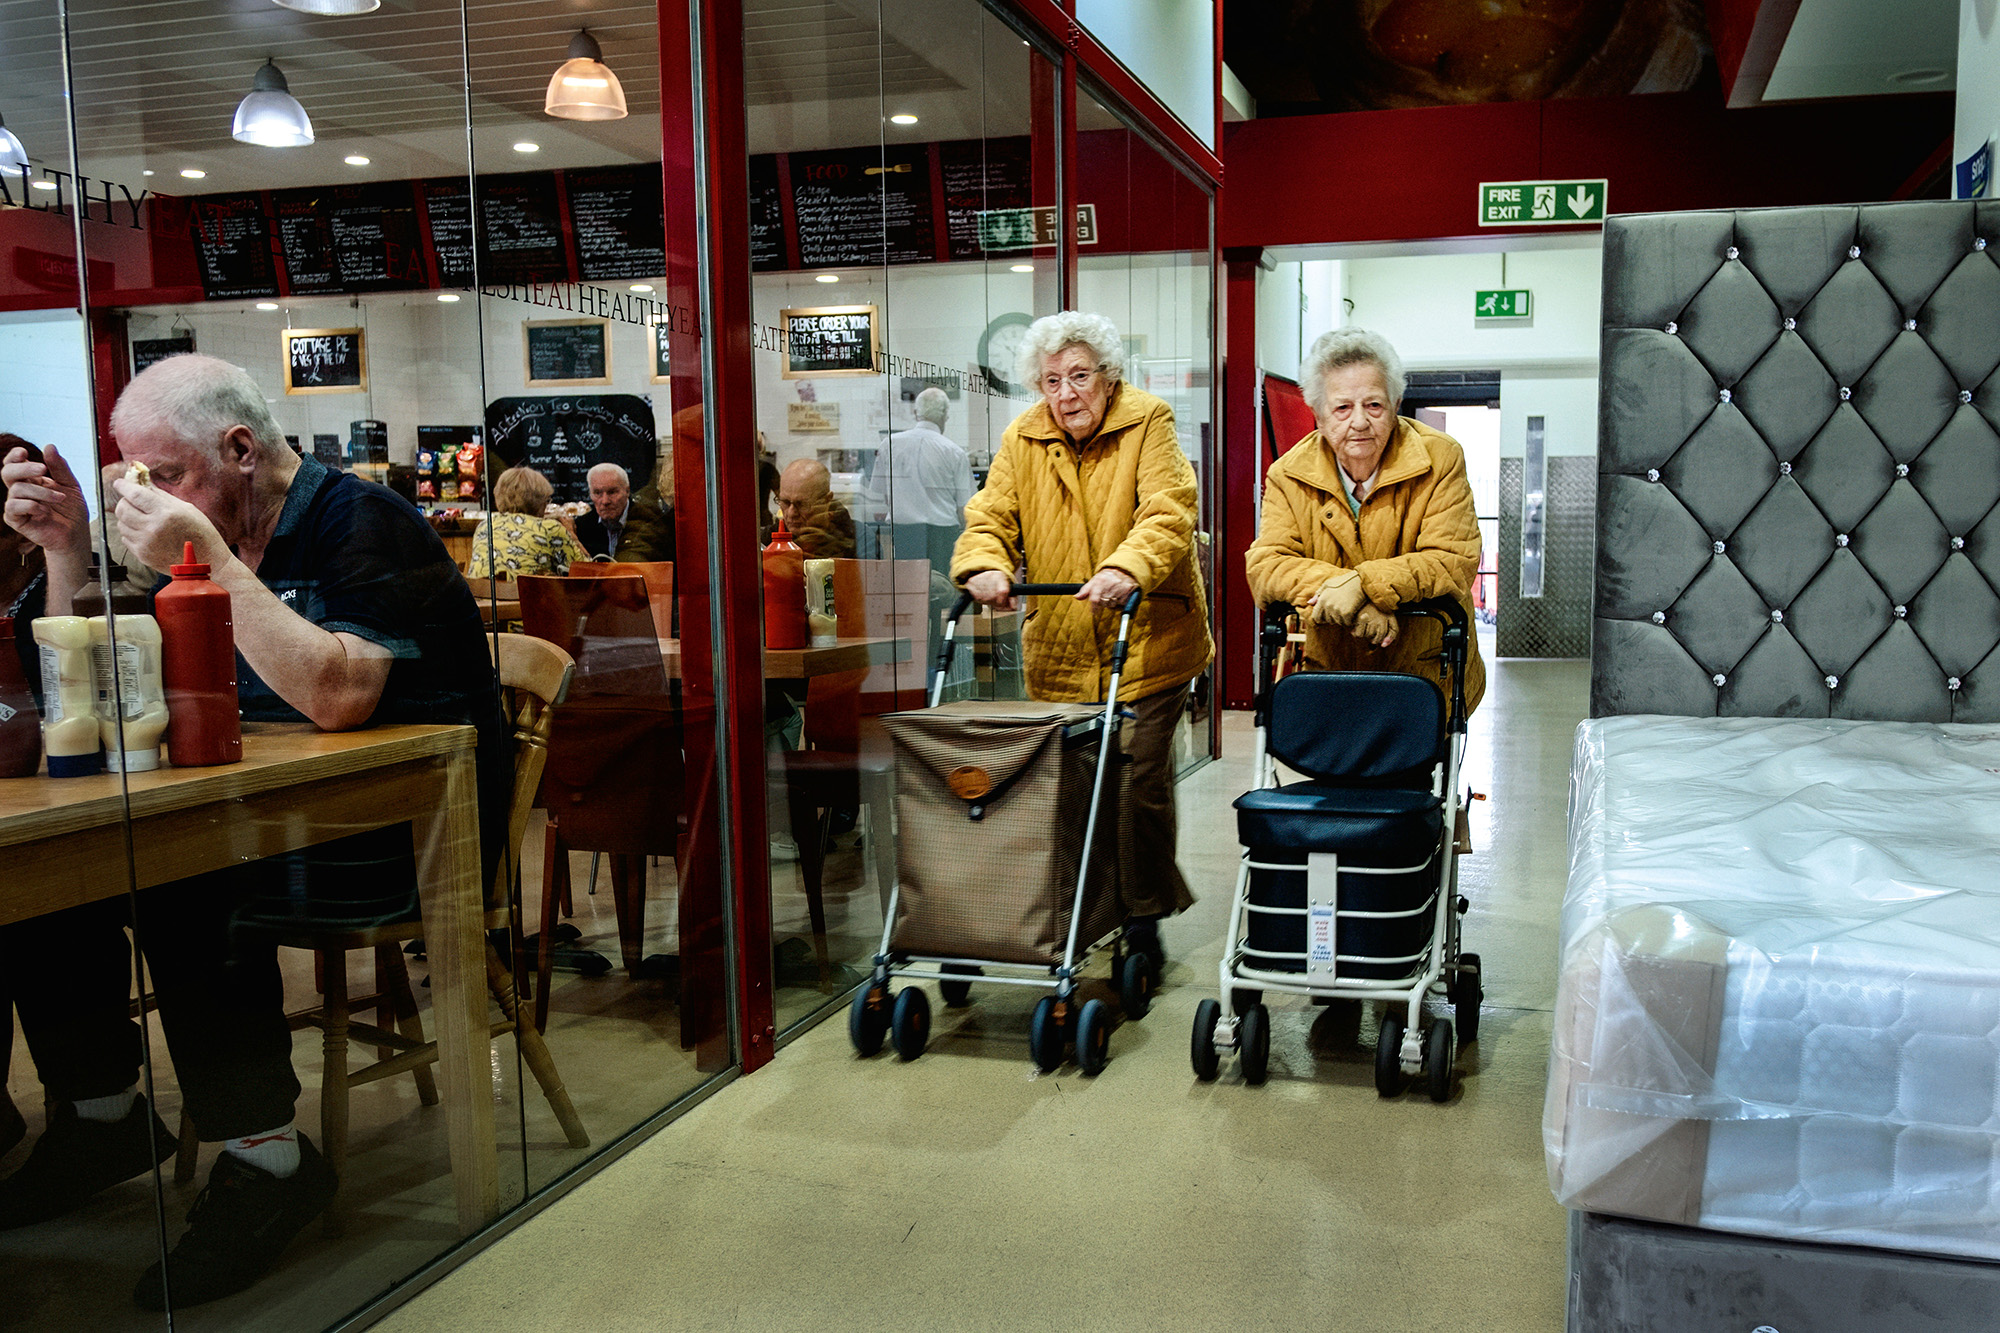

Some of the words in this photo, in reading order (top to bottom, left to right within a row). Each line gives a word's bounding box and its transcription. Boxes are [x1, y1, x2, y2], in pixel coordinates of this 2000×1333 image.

[804, 164, 848, 182] FOOD
[1488, 188, 1522, 203] FIRE
[1488, 206, 1522, 219] EXIT
[678, 306, 703, 338] EA
[789, 317, 819, 332] PLEASE
[819, 315, 847, 331] ORDER
[291, 337, 332, 355] COTTAGE
